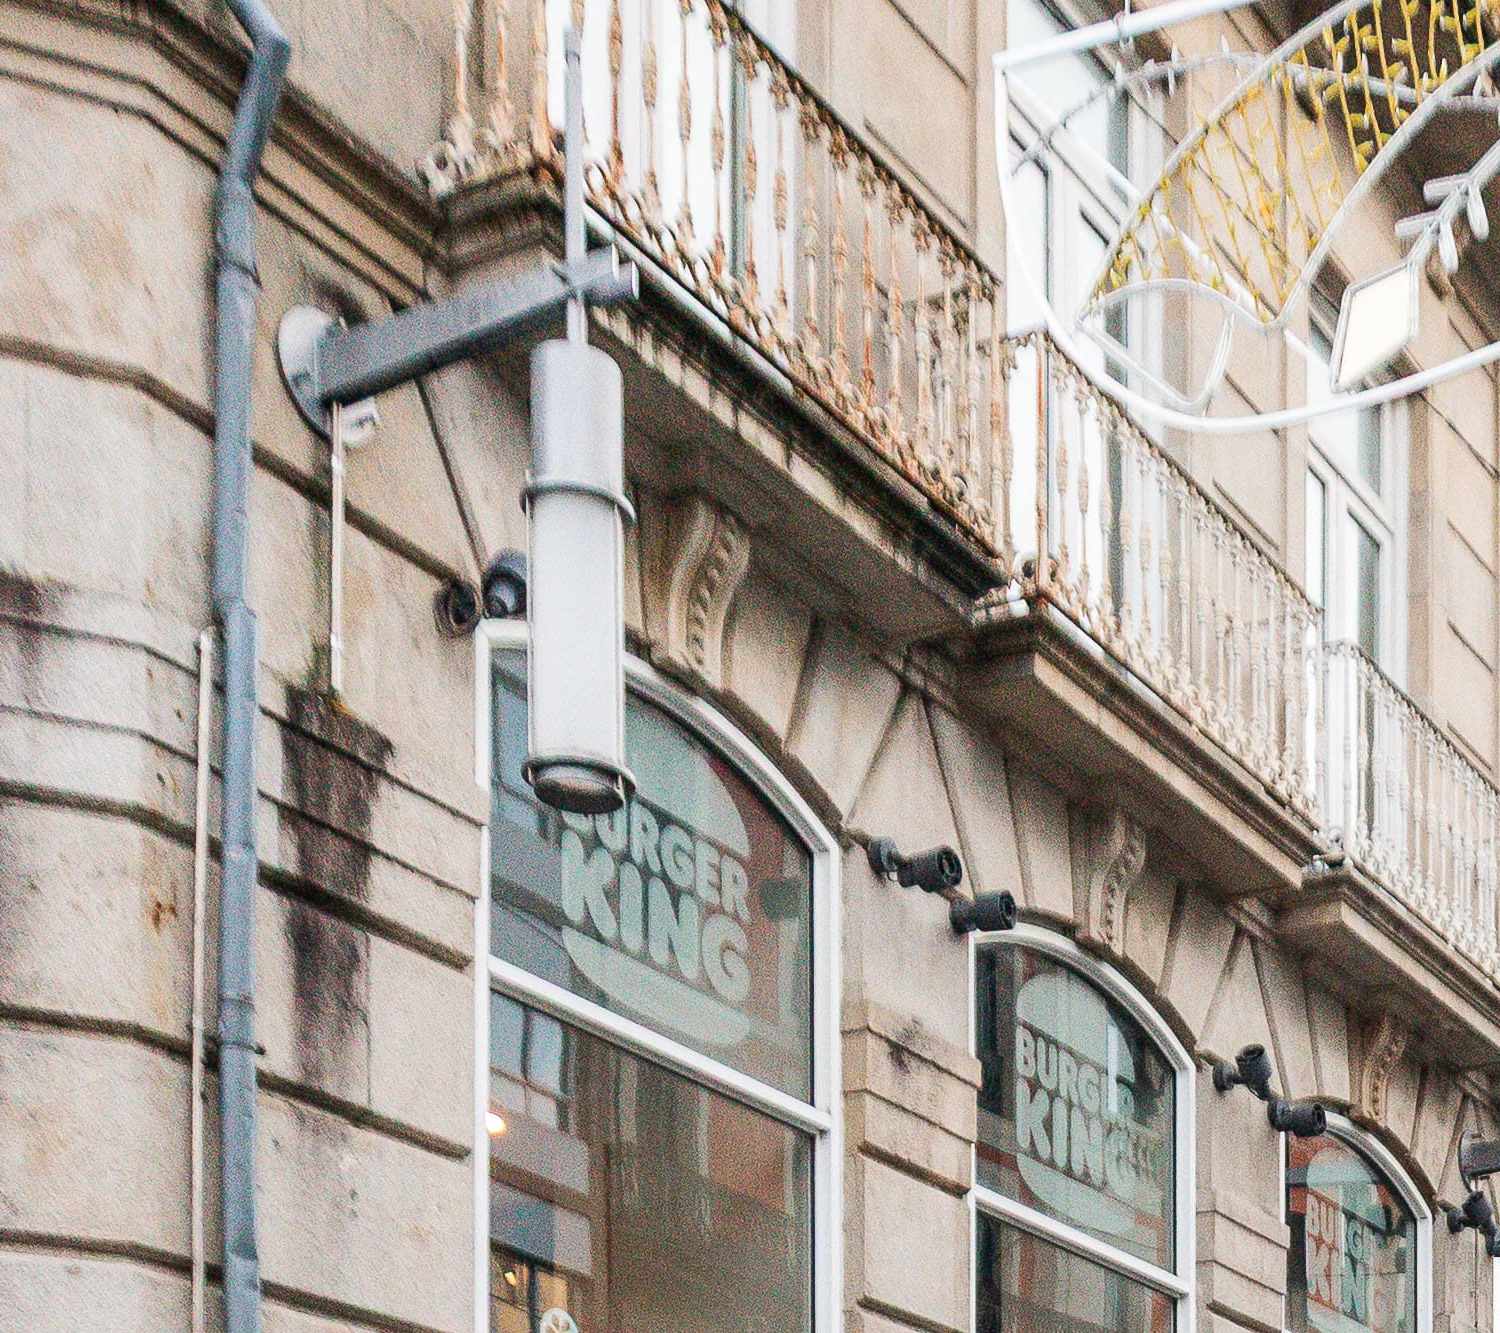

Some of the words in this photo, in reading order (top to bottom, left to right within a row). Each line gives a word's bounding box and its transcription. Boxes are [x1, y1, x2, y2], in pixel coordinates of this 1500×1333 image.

[560, 827, 751, 1003] KING
[561, 799, 750, 923] URGER
[1015, 1077, 1137, 1201] KING
